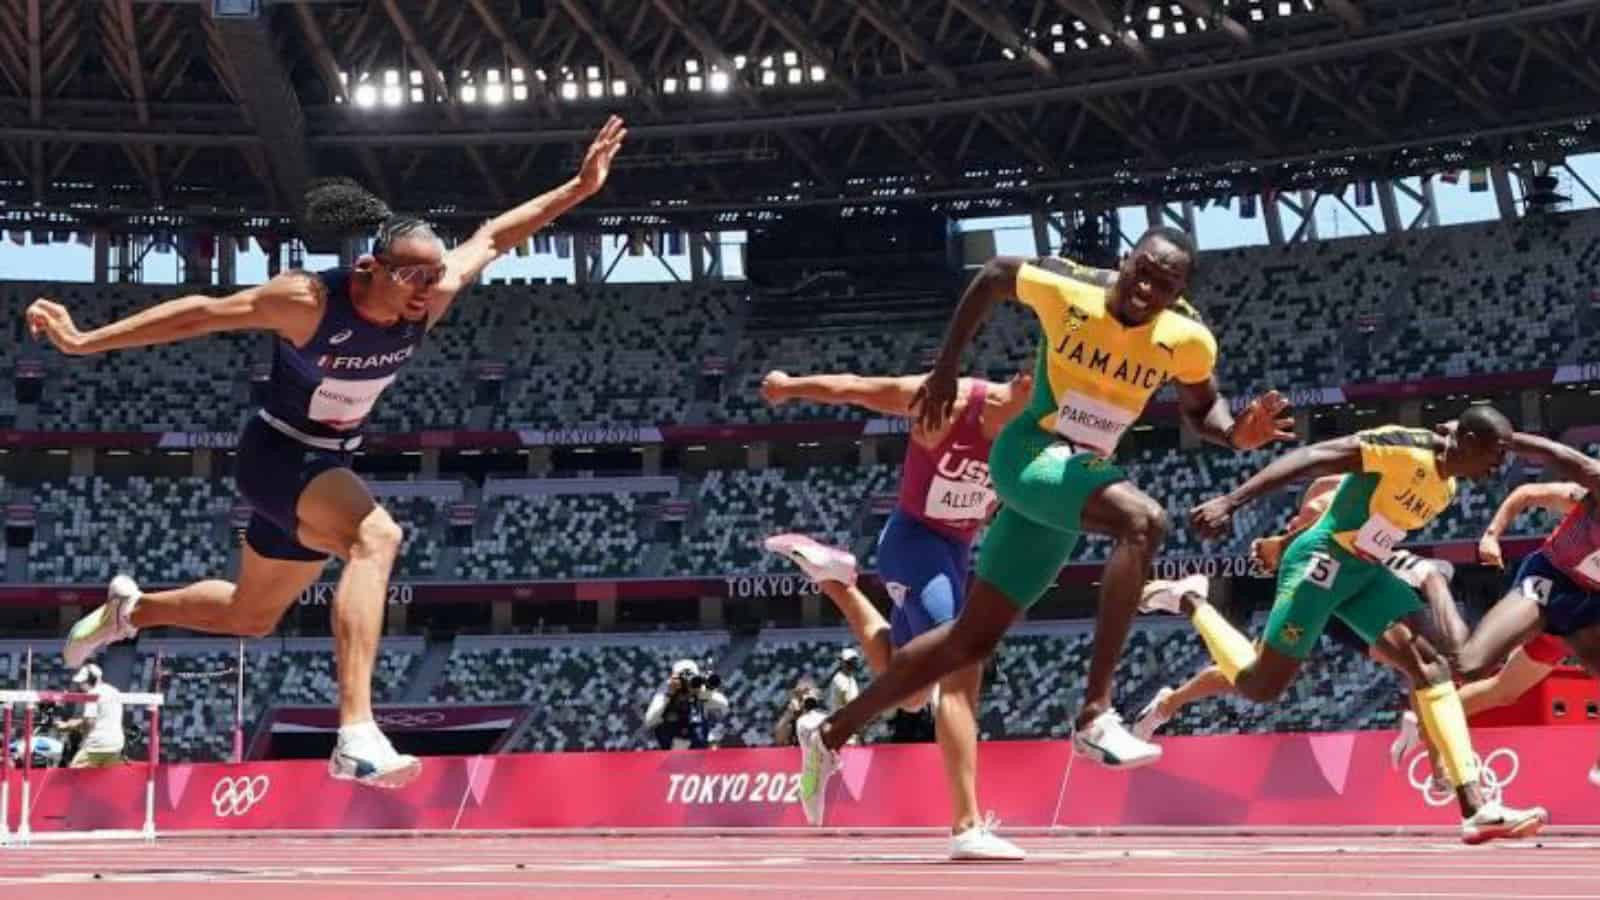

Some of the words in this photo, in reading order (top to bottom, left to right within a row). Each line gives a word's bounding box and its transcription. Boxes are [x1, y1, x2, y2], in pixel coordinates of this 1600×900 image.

[544, 429, 598, 445] TOKYO
[600, 427, 640, 443] 2020
[1152, 559, 1217, 579] TOKYO
[1311, 559, 1329, 582] 5
[726, 577, 793, 598] TOKYO
[667, 773, 750, 804] TOKYO
[749, 772, 801, 803] 202
